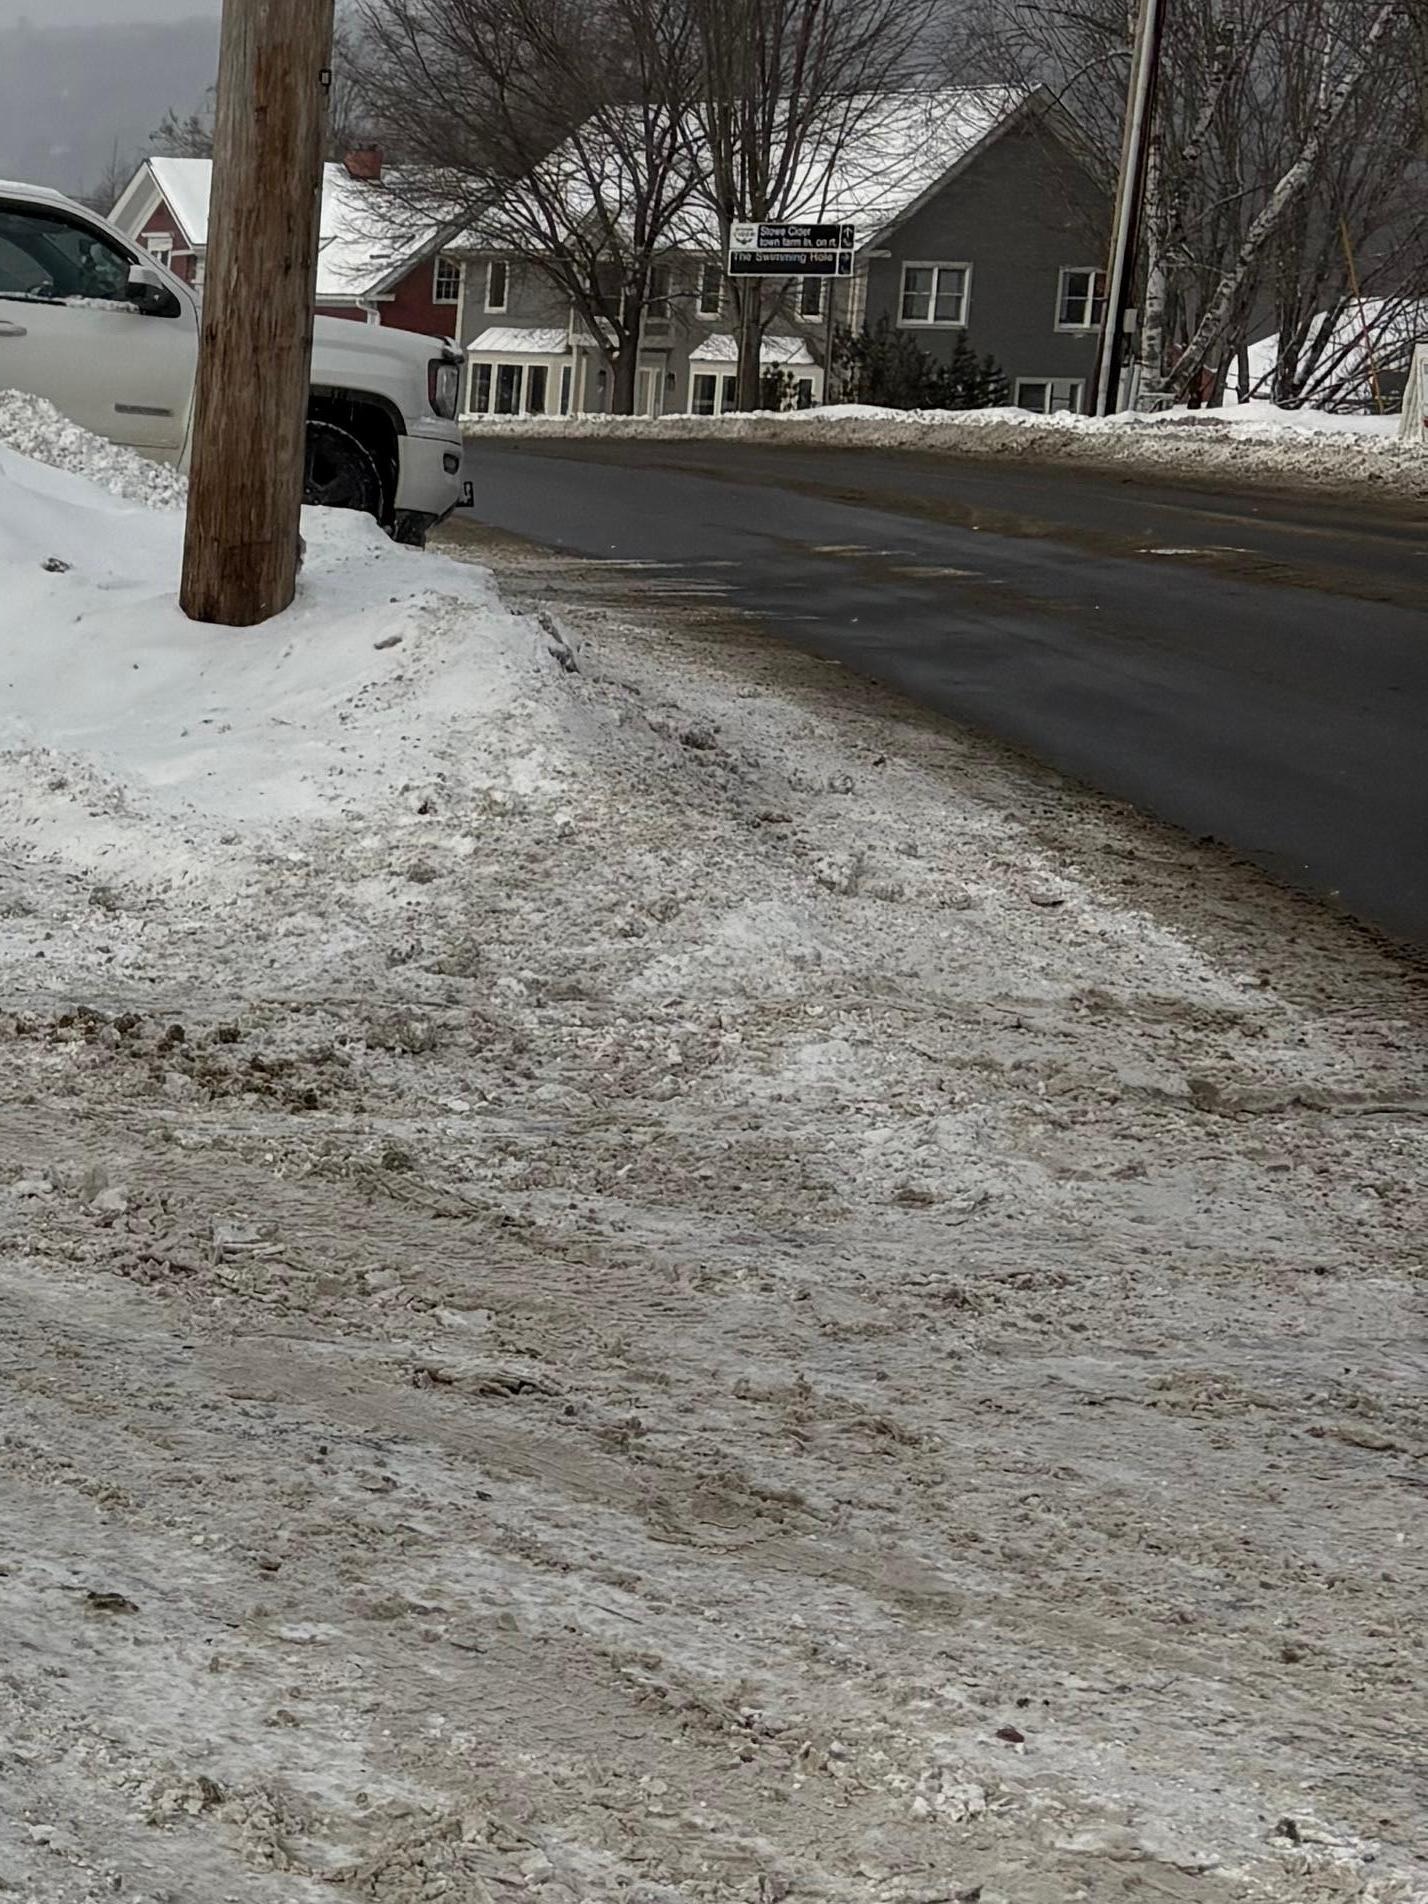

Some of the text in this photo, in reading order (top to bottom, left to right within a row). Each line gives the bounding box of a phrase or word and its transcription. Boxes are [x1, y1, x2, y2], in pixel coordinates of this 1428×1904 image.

[760, 226, 786, 236] Stowe
[787, 226, 811, 236] Cider
[755, 252, 807, 264] Swimming
